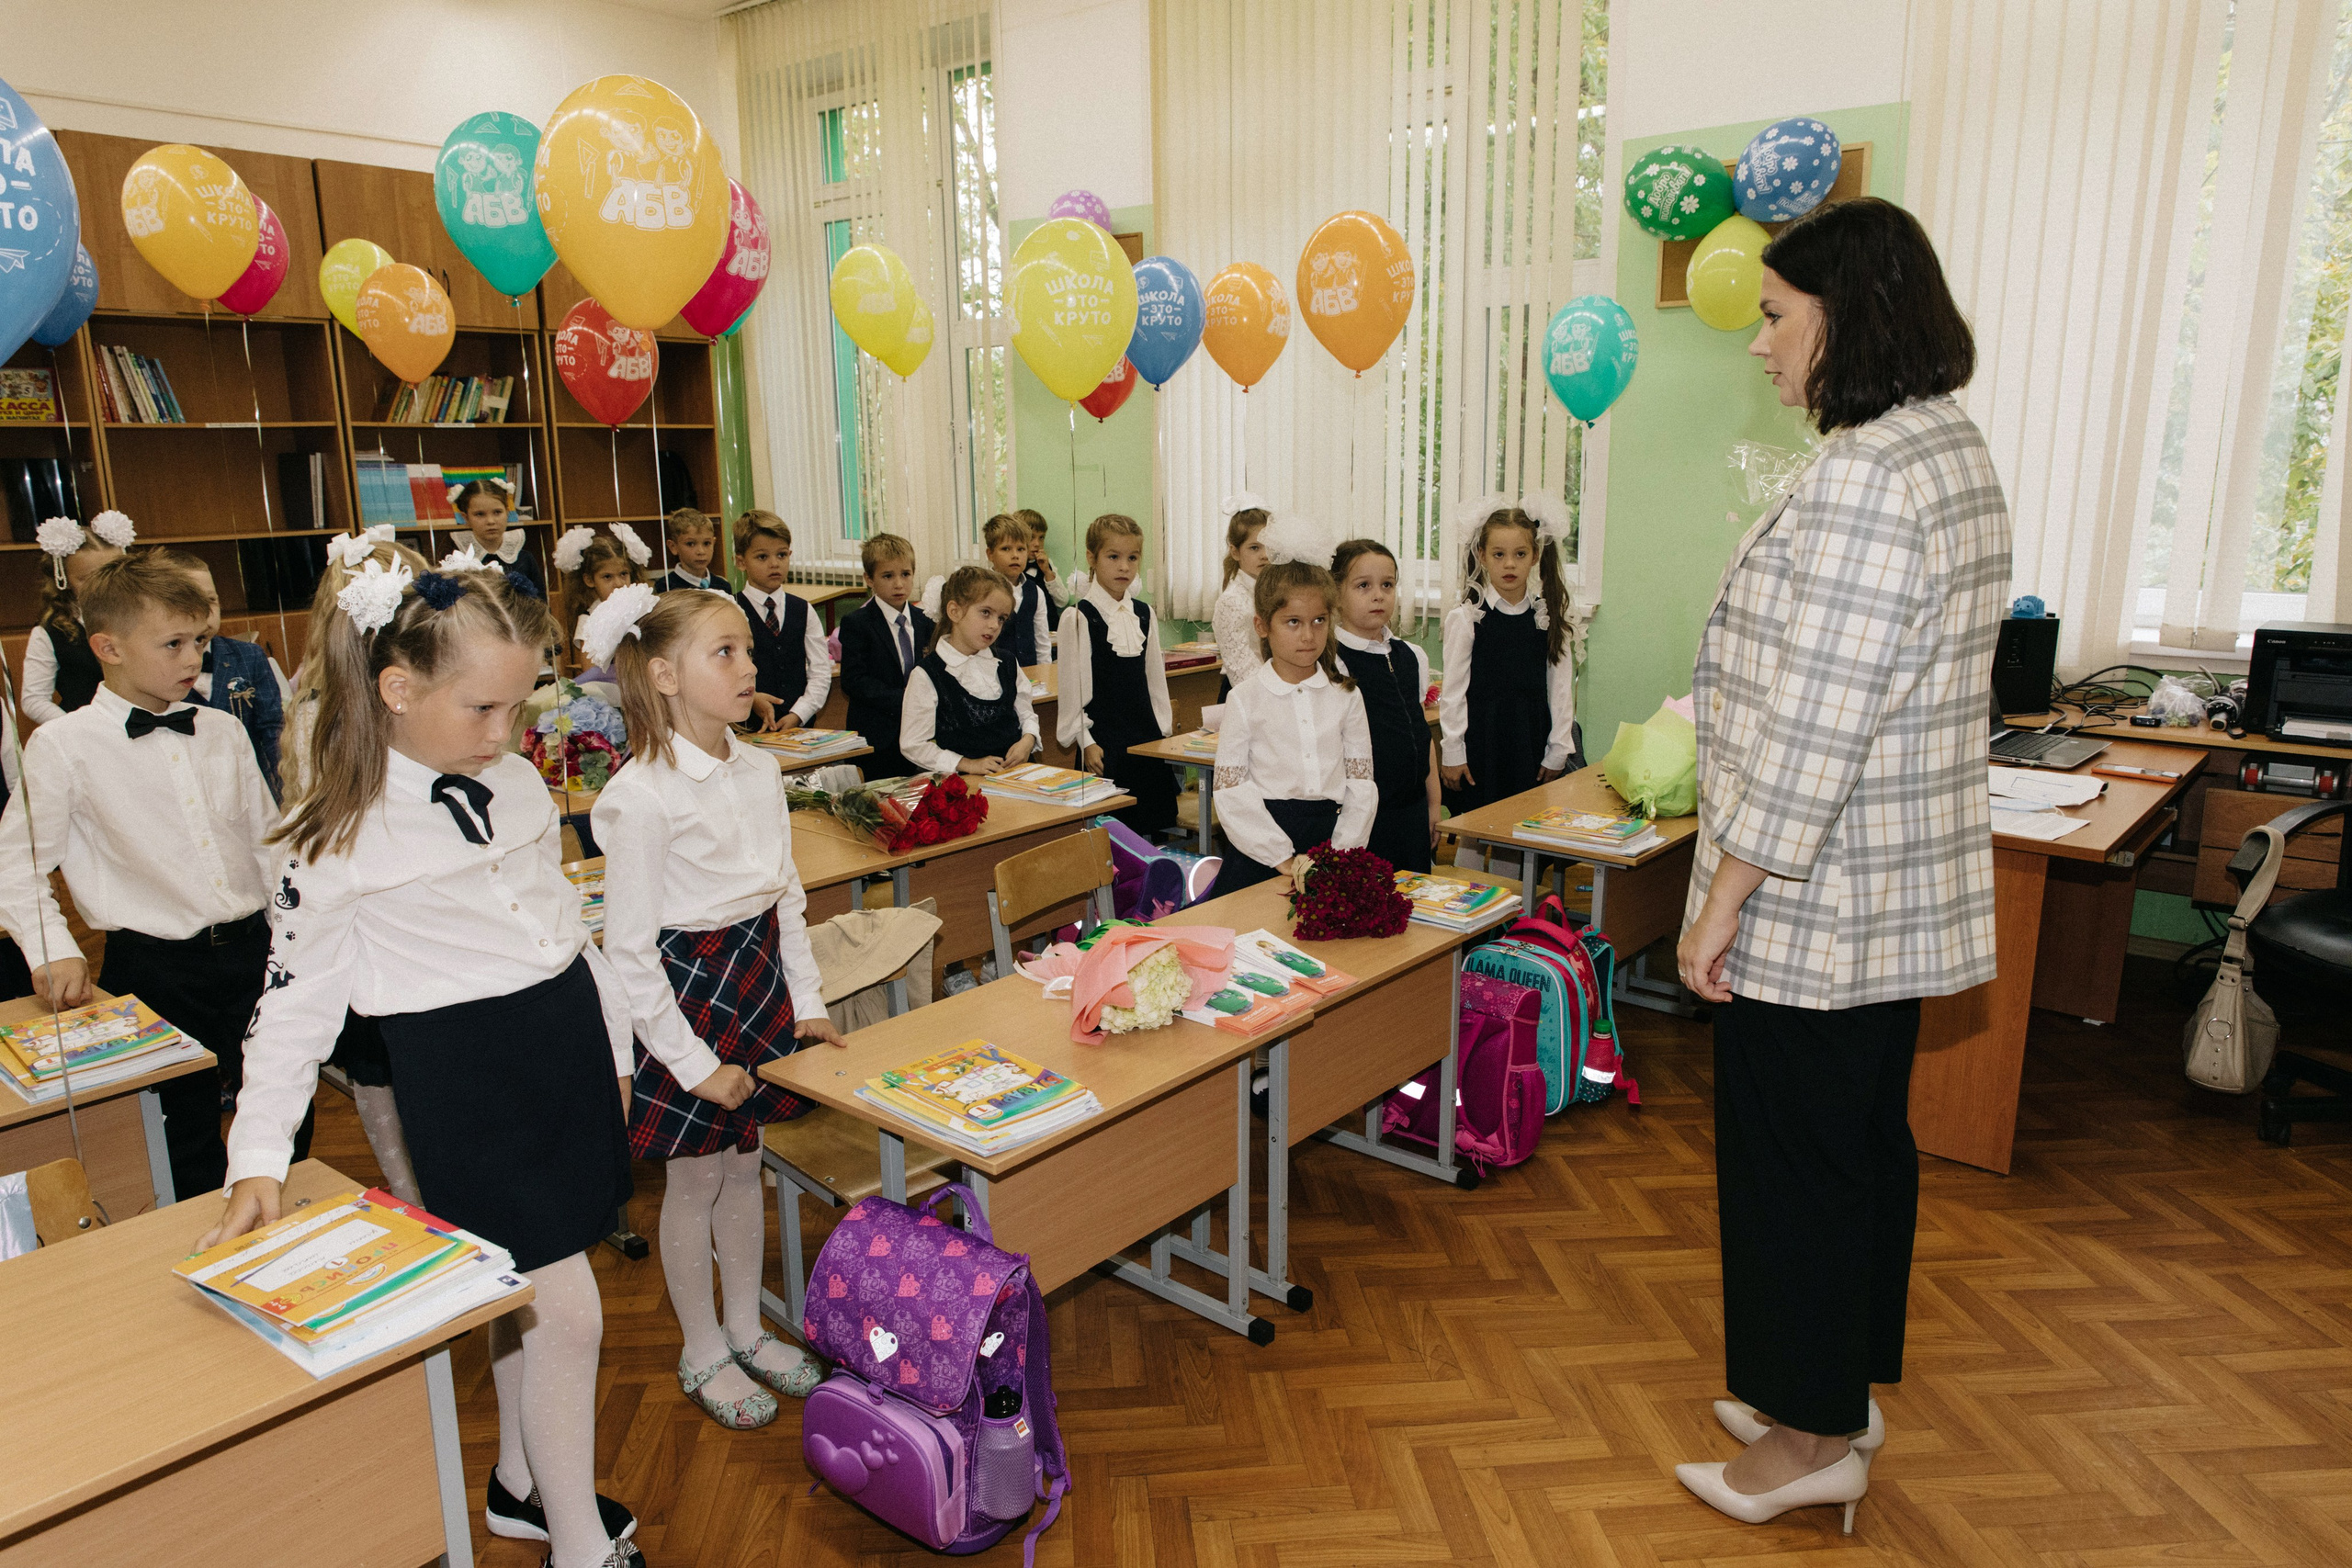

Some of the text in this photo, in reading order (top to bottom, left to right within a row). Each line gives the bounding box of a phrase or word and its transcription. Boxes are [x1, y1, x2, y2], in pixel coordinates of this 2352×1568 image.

[195, 184, 253, 209] ШКОЛА
[1648, 173, 1672, 208] Добро
[461, 192, 529, 229] АБВ
[598, 177, 695, 231] АБВ
[207, 211, 253, 231] КРУТО
[726, 247, 770, 281] АБВ
[1386, 260, 1414, 279] ШКО
[1045, 274, 1114, 296] ШКОЛА
[1137, 290, 1185, 306] ШКОЛА
[1309, 287, 1359, 317] АБВ
[358, 319, 379, 330] РУТО
[408, 312, 448, 336] АБВ
[1054, 310, 1112, 326] КРУТО
[1141, 315, 1182, 326] КРУТО
[1205, 316, 1238, 328] КРУТО
[1267, 313, 1291, 337] АБ
[555, 355, 576, 366] РУТО
[606, 356, 652, 381] АБВ
[1549, 352, 1591, 377] АБВ
[1102, 365, 1125, 383] БВ
[1509, 967, 1552, 992] QUEEN
[65, 1026, 165, 1061] БУКВАРЬ
[987, 1076, 1065, 1108] БУКВАРЬ
[300, 1242, 399, 1292] ПРОПИСЬ
